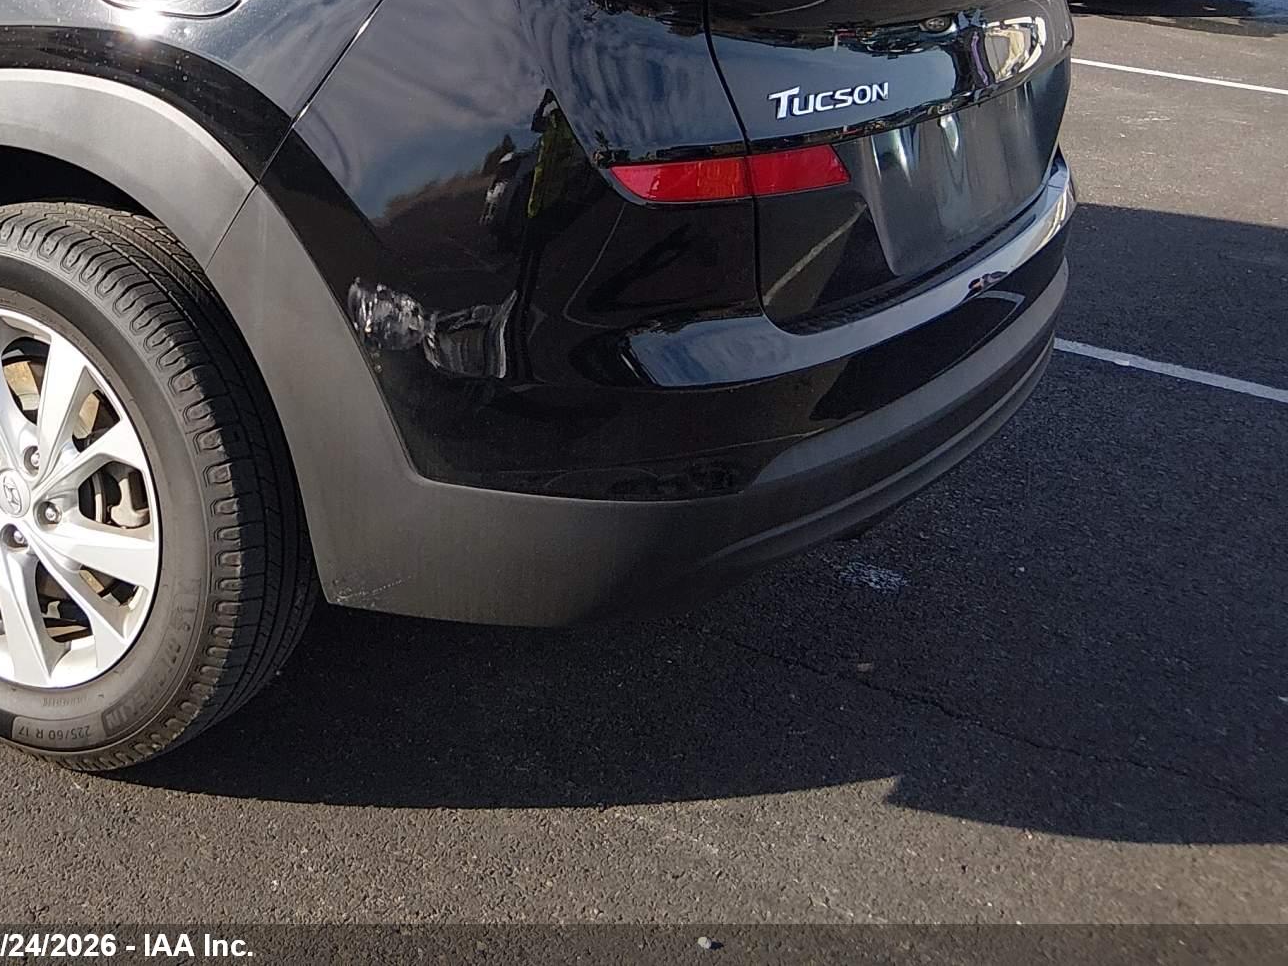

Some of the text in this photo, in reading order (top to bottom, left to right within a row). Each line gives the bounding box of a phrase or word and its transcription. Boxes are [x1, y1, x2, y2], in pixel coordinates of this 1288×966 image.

[768, 82, 889, 120] TUCSON
[35, 729, 44, 739] R
[48, 725, 91, 740] 225/60
